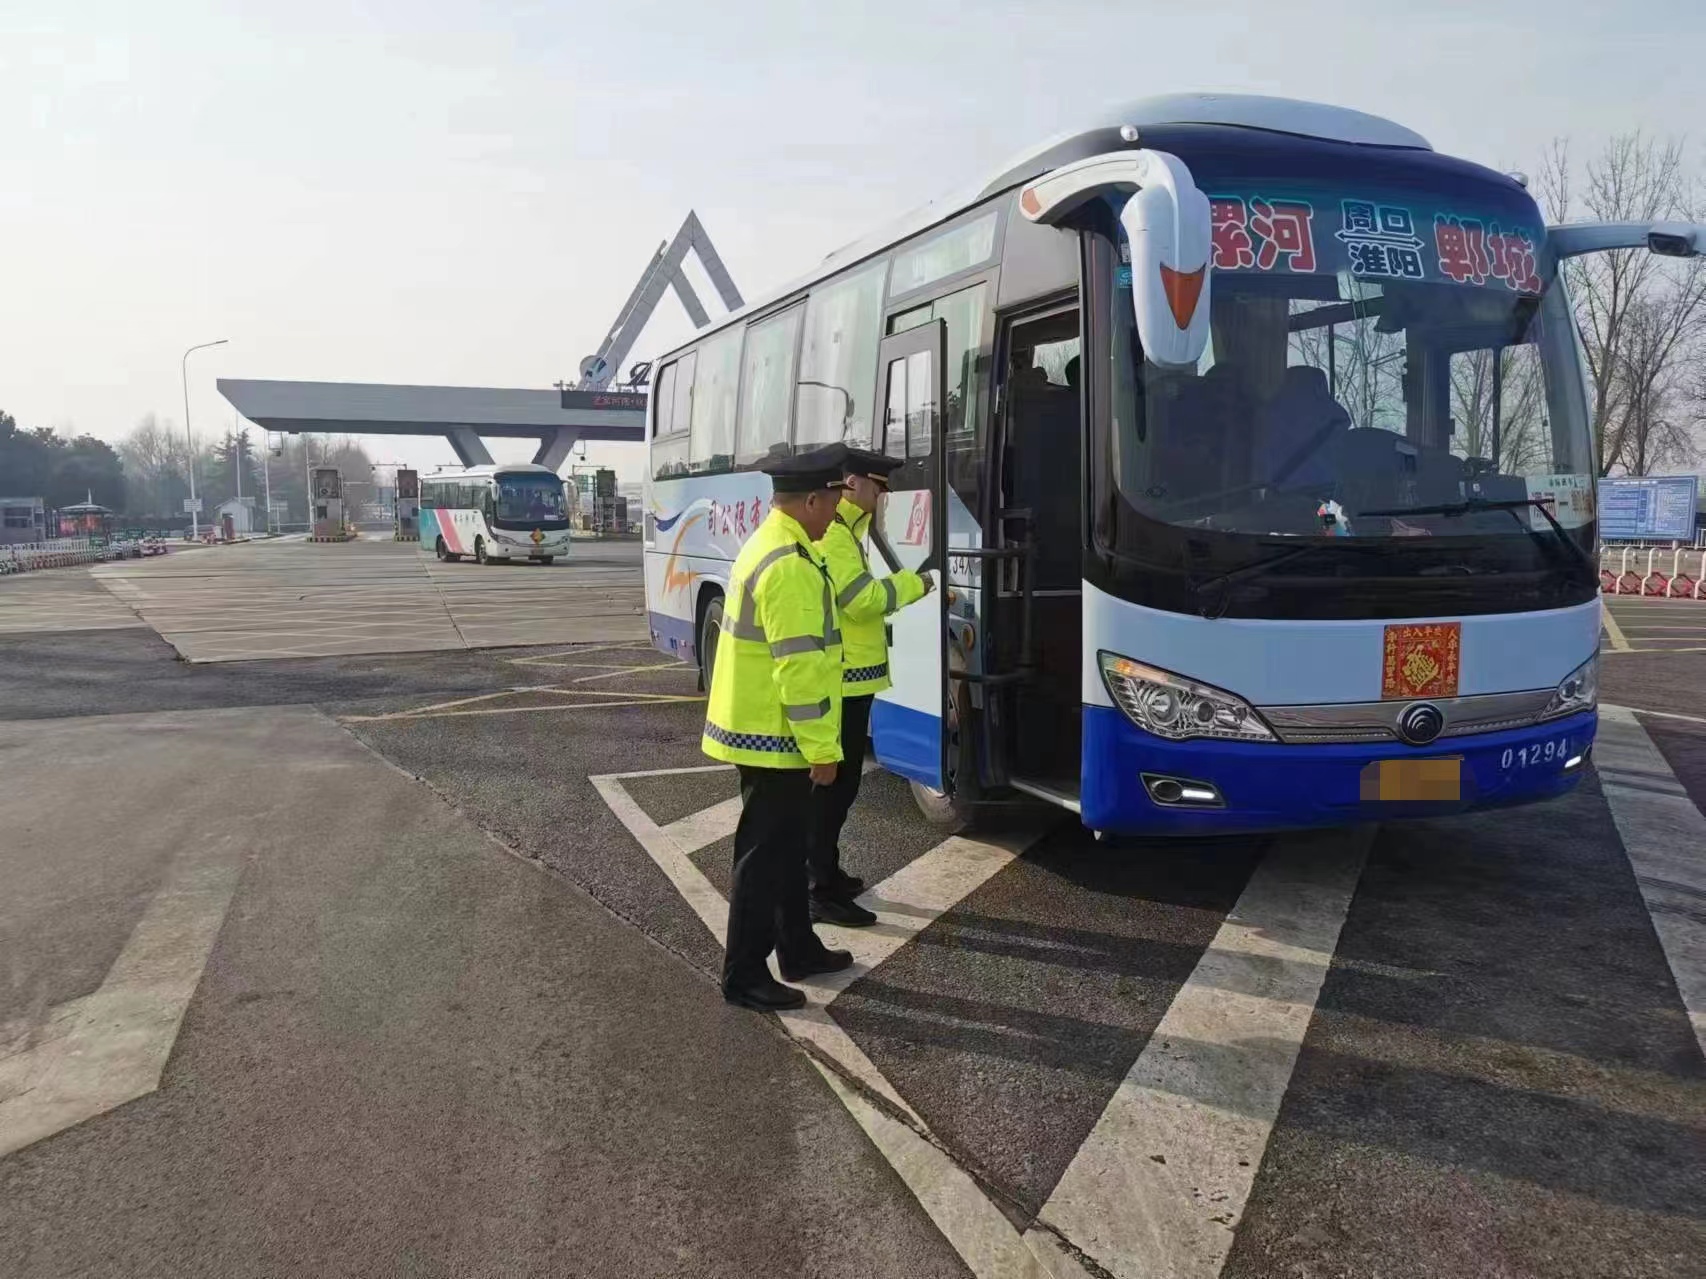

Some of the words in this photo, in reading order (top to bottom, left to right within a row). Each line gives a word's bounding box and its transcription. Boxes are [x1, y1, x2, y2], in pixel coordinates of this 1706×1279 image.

[1341, 200, 1414, 235] 周口
[1348, 243, 1424, 278] 淮阳
[1501, 738, 1567, 769] 01294
